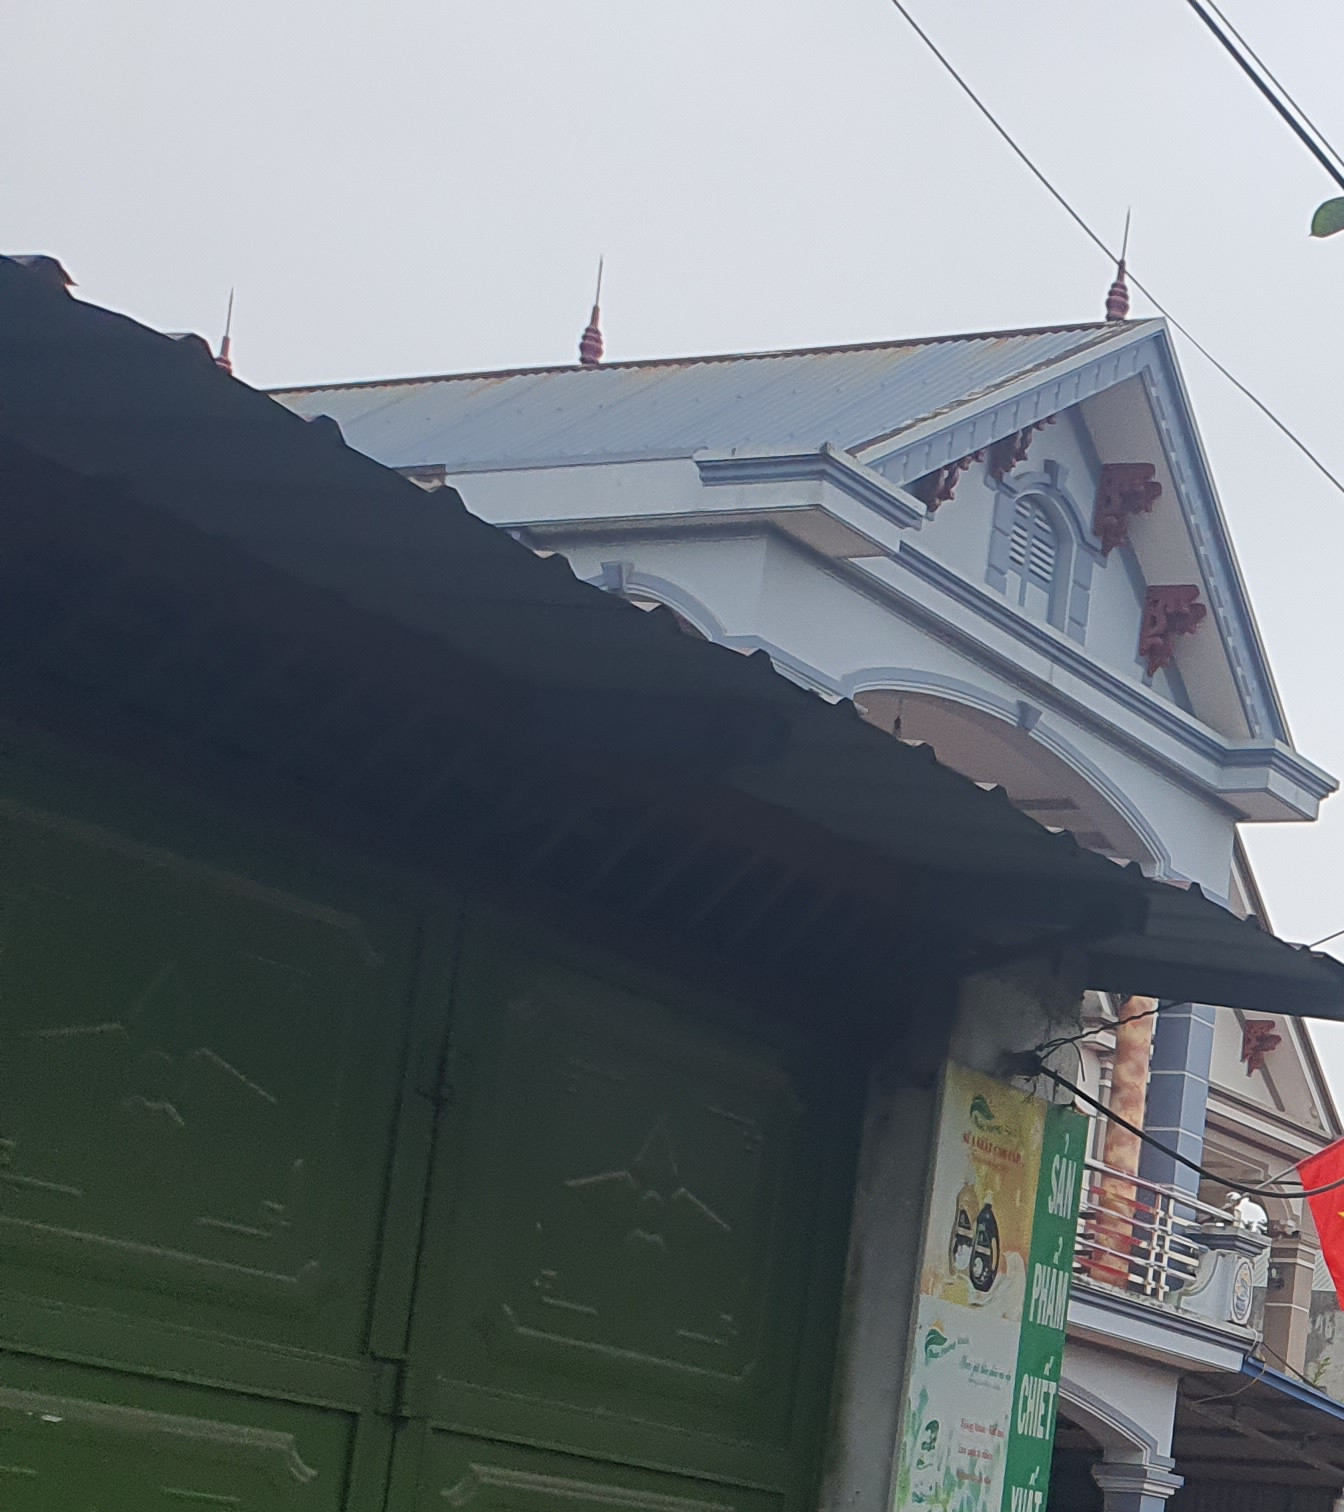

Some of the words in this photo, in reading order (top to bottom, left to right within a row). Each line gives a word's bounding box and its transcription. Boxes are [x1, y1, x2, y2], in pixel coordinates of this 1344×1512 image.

[1049, 1133, 1077, 1220] SẢN
[1029, 1236, 1069, 1331] PHẨM
[1018, 1356, 1057, 1440] CHIẾT
